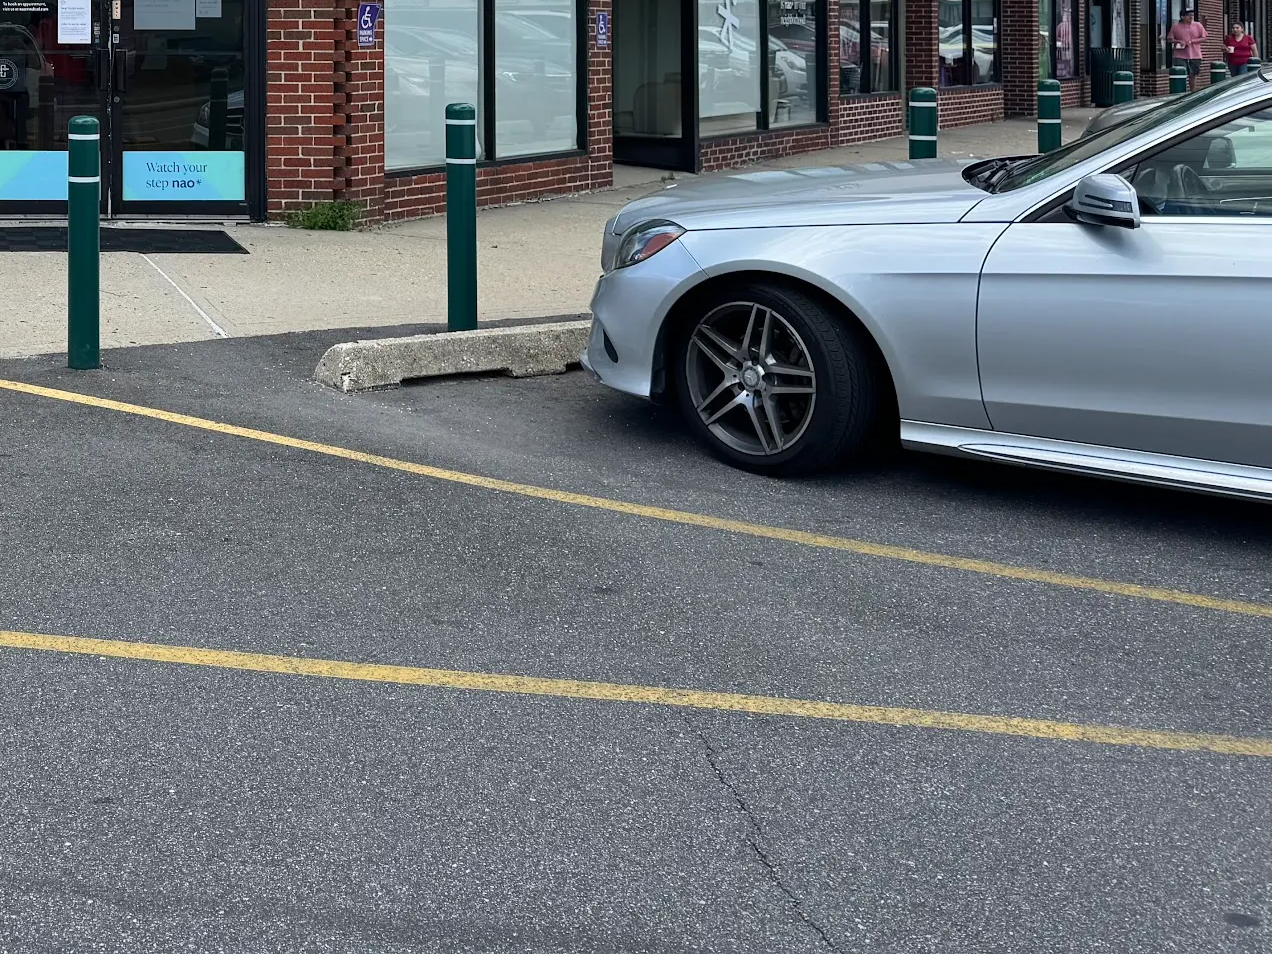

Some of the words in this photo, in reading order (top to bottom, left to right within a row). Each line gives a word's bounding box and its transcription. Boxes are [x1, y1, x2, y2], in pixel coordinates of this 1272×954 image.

[146, 161, 180, 173] Watch
[182, 164, 208, 176] your
[146, 178, 169, 191] step
